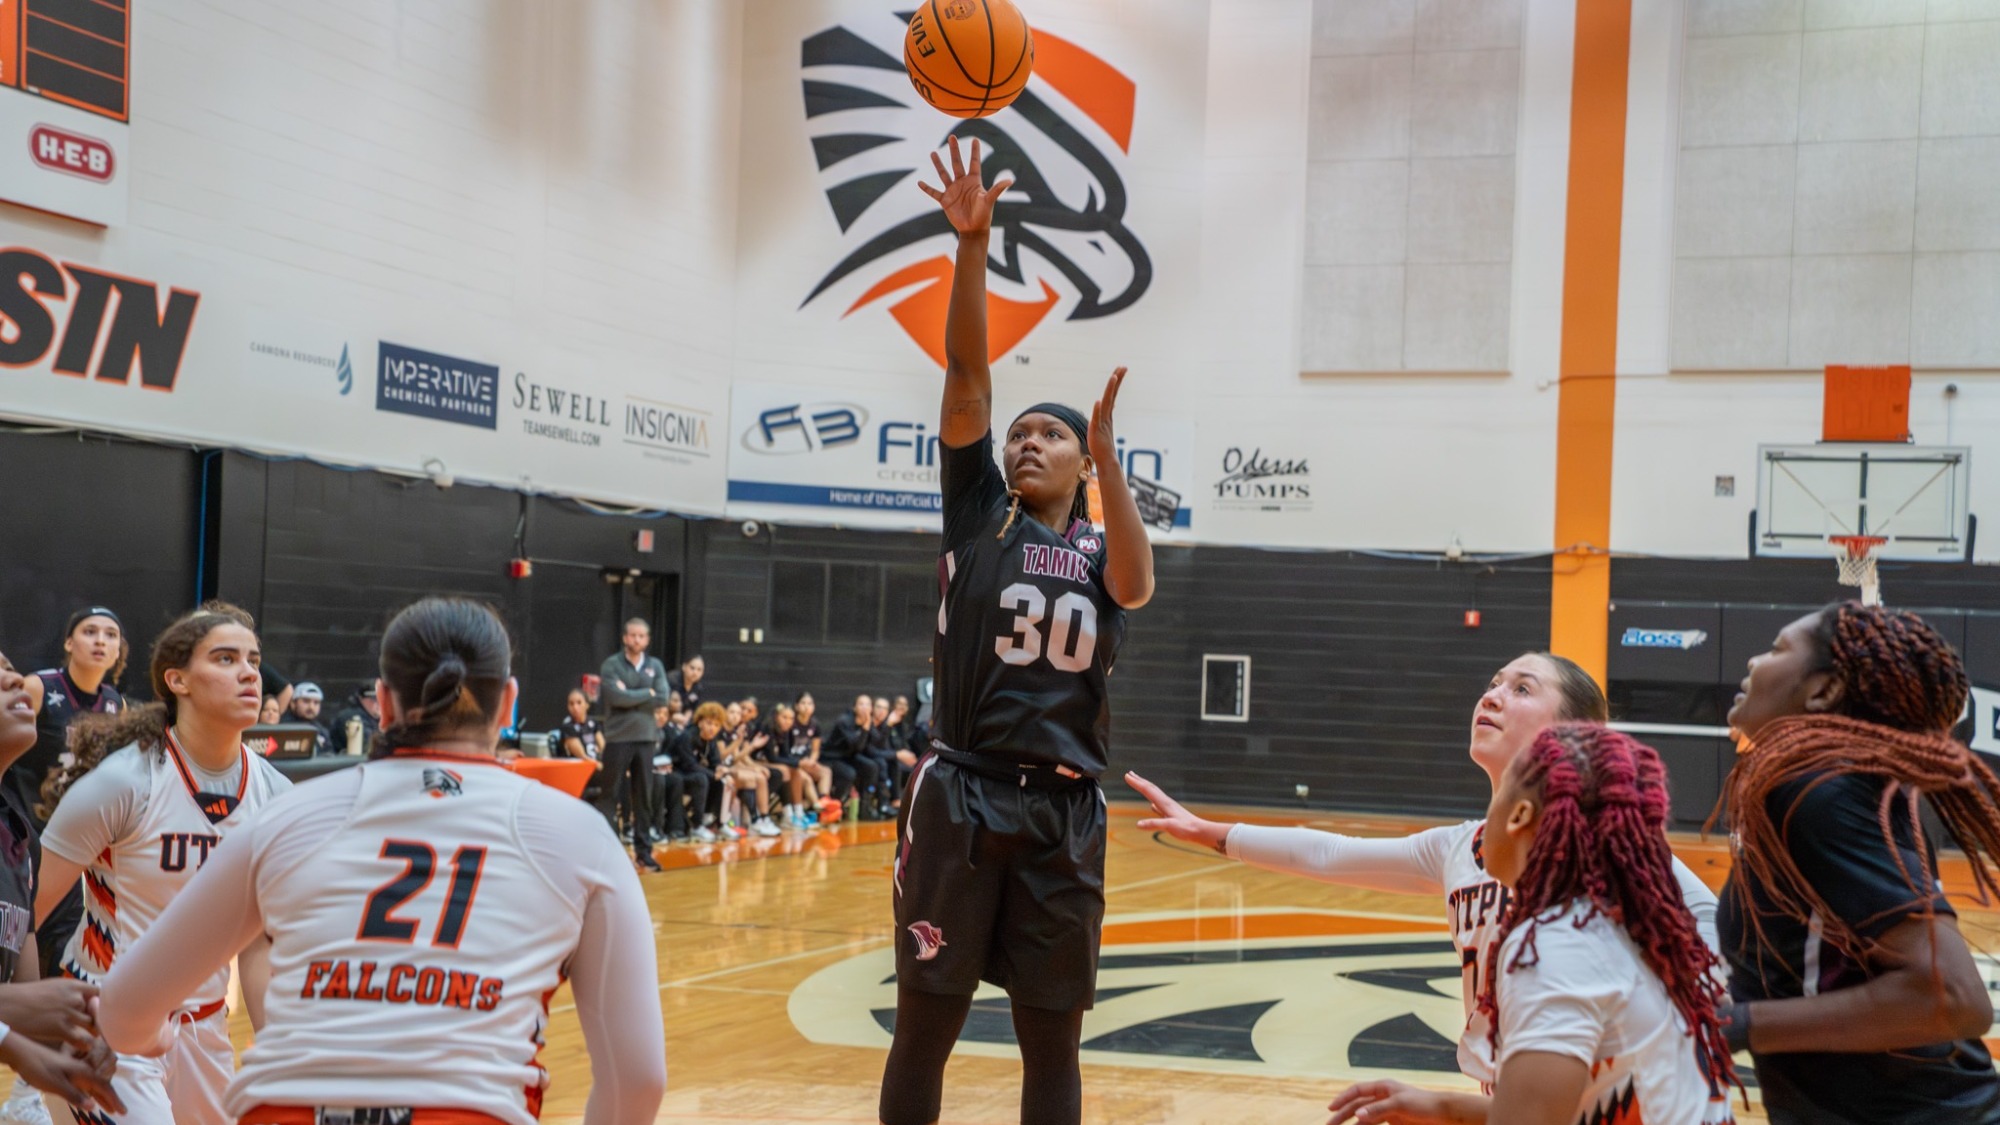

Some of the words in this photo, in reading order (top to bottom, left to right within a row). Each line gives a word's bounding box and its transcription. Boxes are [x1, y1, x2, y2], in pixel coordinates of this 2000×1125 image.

[384, 356, 493, 402] IMPERATIVE
[383, 385, 437, 408] CHEMICAL
[440, 396, 493, 418] PARTNERS
[522, 419, 602, 447] TEAMSEWELL.COM
[625, 404, 710, 450] INSIGNIA
[1219, 446, 1310, 482] Odessa
[829, 488, 862, 504] Home
[862, 491, 875, 506] of
[875, 492, 895, 508] the
[895, 493, 932, 509] Official
[1213, 482, 1311, 499] PUMPS
[995, 582, 1098, 673] 30
[355, 837, 488, 950] 21
[300, 960, 504, 1011] FALCONS
